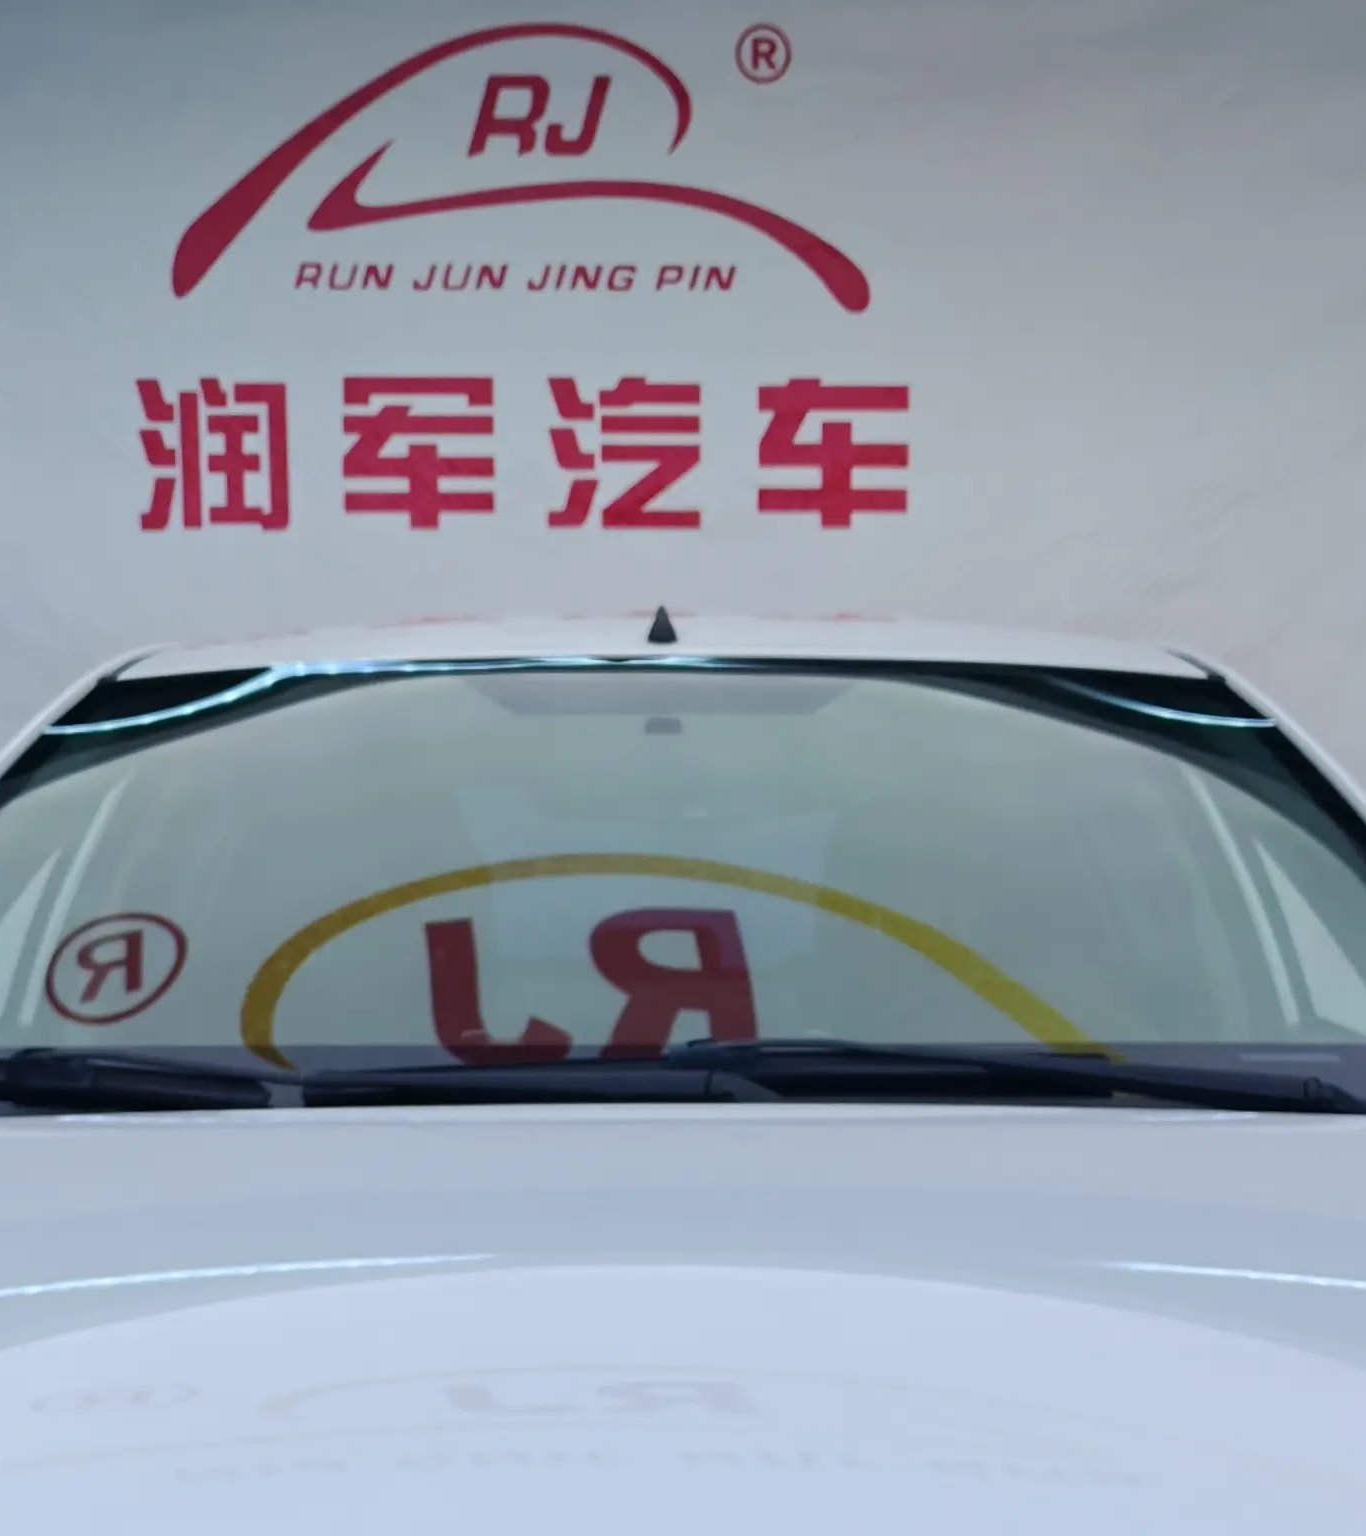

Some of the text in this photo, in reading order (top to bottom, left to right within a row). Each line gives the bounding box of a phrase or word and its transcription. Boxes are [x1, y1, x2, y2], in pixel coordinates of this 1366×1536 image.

[467, 74, 611, 157] RJ
[294, 261, 739, 293] RUN JUN JING PIN
[135, 375, 911, 531] 润军汽车
